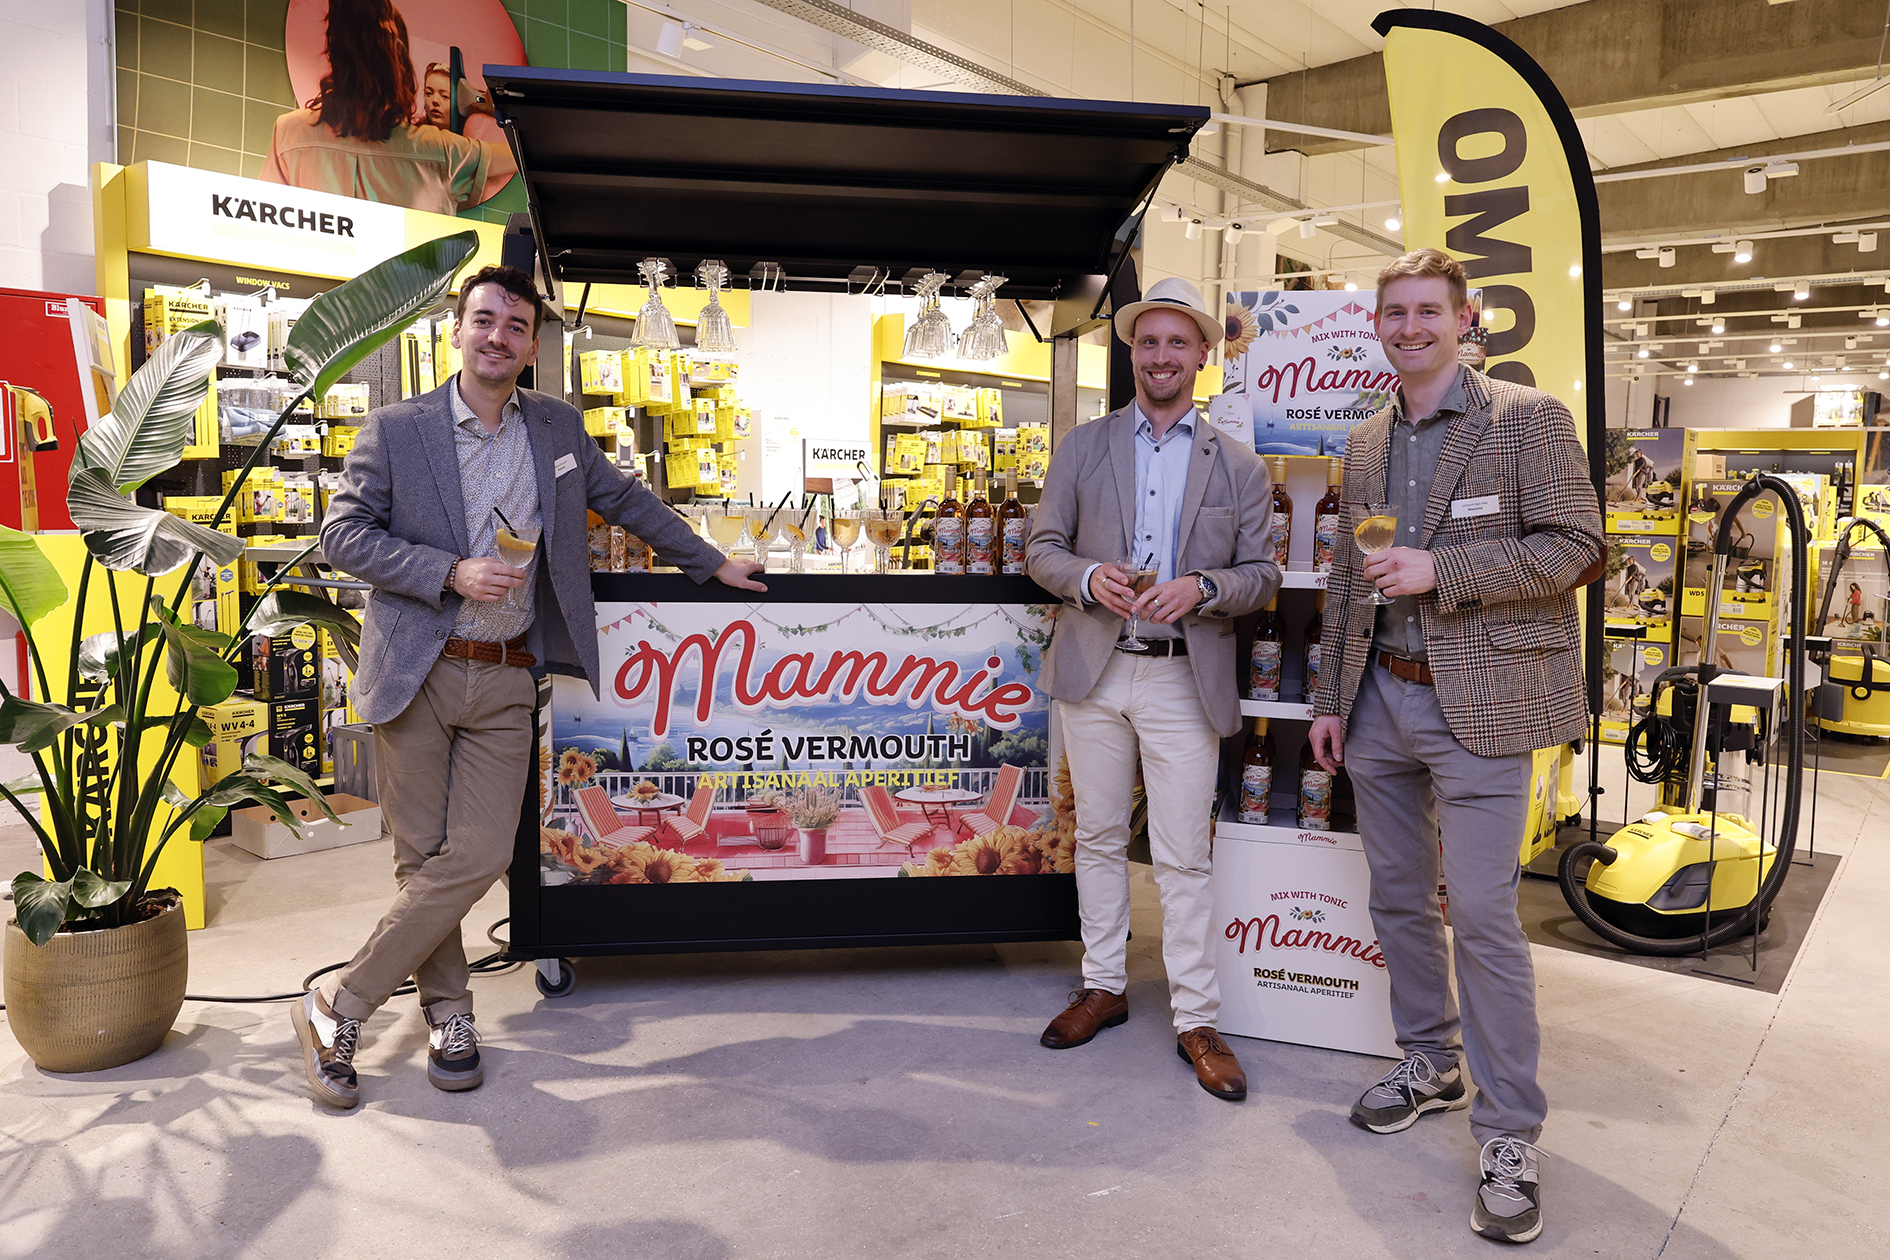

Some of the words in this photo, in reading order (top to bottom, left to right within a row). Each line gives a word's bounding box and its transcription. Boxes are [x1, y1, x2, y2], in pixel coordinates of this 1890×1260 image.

[212, 194, 355, 238] KÄRCHER
[235, 276, 271, 288] WINDOW
[1311, 331, 1330, 343] MIX
[1331, 330, 1356, 339] WITH
[1358, 330, 1381, 341] TONI
[1286, 406, 1321, 420] ROSÉ
[1289, 423, 1348, 431] ARTISANAAL
[812, 447, 866, 460] KÄRCHER
[614, 620, 1032, 737] Mammie
[221, 722, 238, 731] WV
[240, 720, 255, 729] 4-4
[686, 729, 774, 763] ROSÉ
[780, 732, 970, 762] VERMOUTH
[698, 772, 842, 790] ARTISANAAL
[844, 769, 960, 788] APERITIEF
[1297, 832, 1337, 845] Mammie
[1270, 892, 1290, 901] MIX
[1291, 891, 1317, 900] WITH
[1319, 894, 1348, 909] TONIC
[1225, 914, 1386, 967] Mammie
[1253, 968, 1286, 981] ROSÉ
[1287, 972, 1359, 990] VERMOUTH
[1257, 980, 1309, 994] ARTISANAAL
[1310, 987, 1355, 999] APERITIEF
